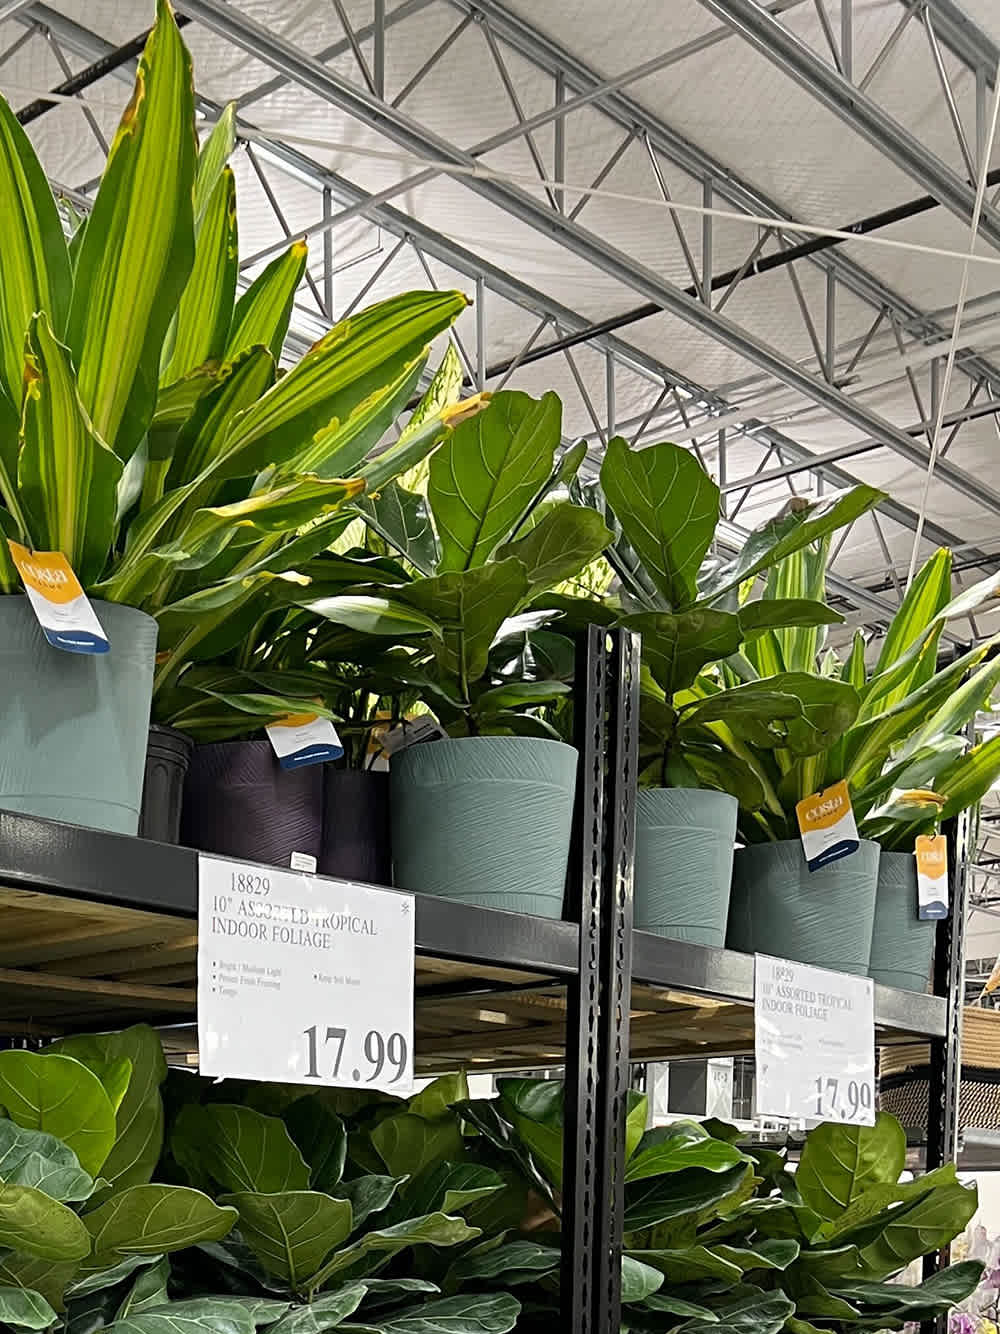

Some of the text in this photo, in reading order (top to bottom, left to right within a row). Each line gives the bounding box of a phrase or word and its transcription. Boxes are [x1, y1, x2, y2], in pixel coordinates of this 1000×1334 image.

[230, 871, 271, 897] 18829
[212, 916, 331, 950] INDOOR FOLIAGE
[761, 999, 793, 1015] INDOOR
[776, 984, 817, 1003] ASSORTED
[303, 1025, 408, 1085] 17.99
[814, 1076, 872, 1121] 17.99
